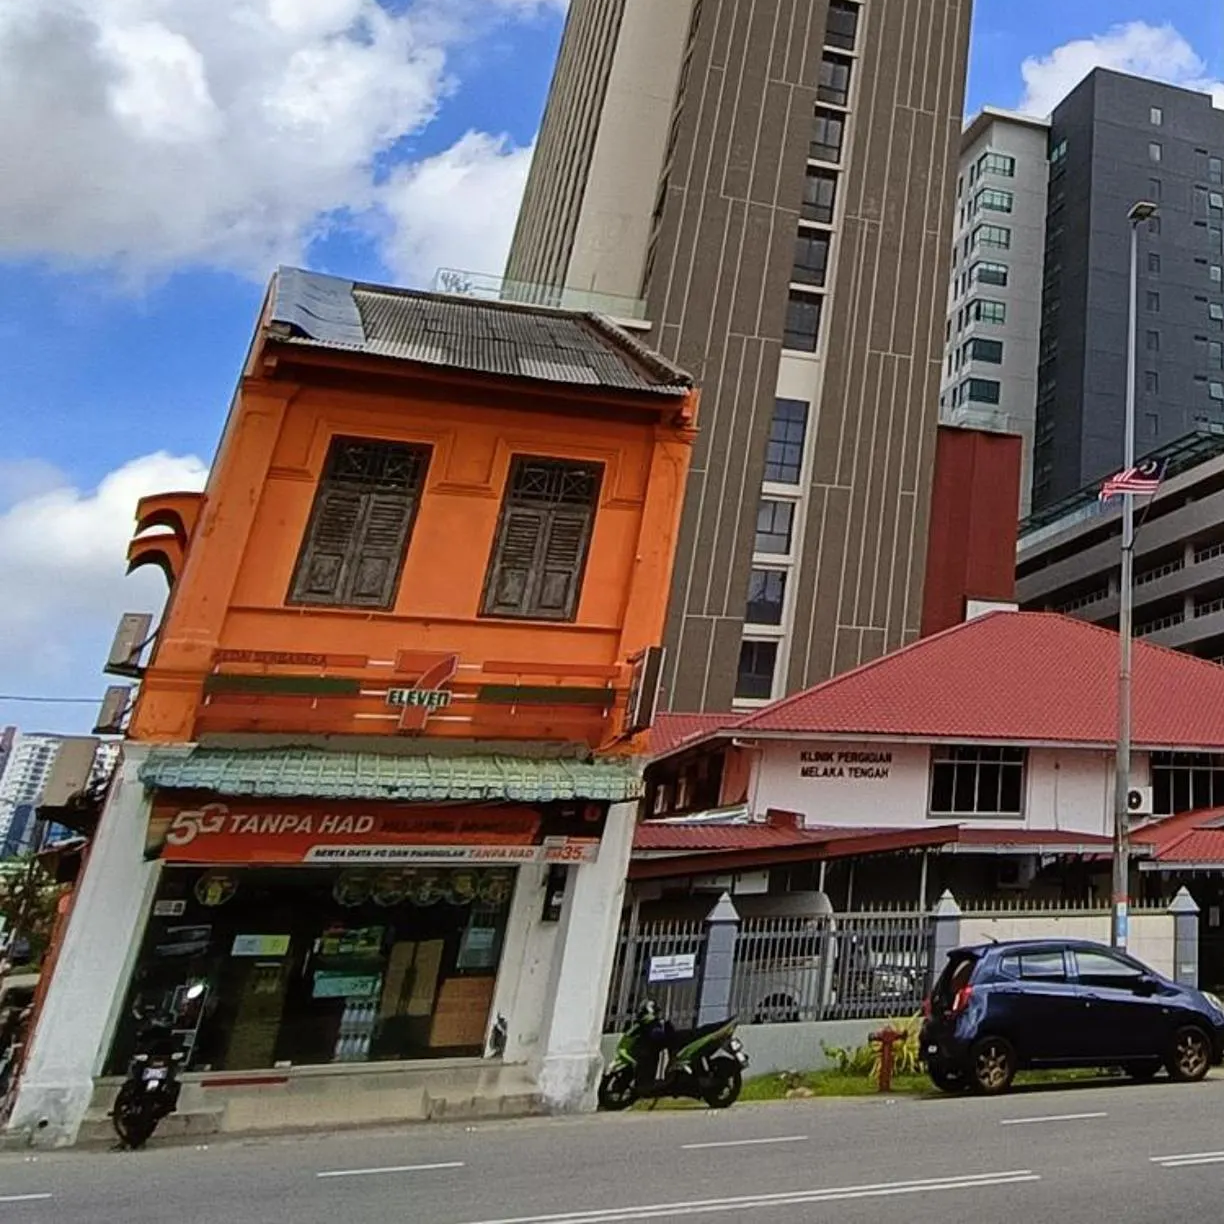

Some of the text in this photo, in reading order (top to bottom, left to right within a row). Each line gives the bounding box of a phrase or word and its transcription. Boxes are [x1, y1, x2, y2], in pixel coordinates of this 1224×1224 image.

[801, 751, 834, 762] KLINIK
[801, 767, 889, 778] MELAKA TENGAH
[167, 803, 229, 846] 5G
[228, 814, 313, 834] TANPA
[318, 815, 375, 834] HAD
